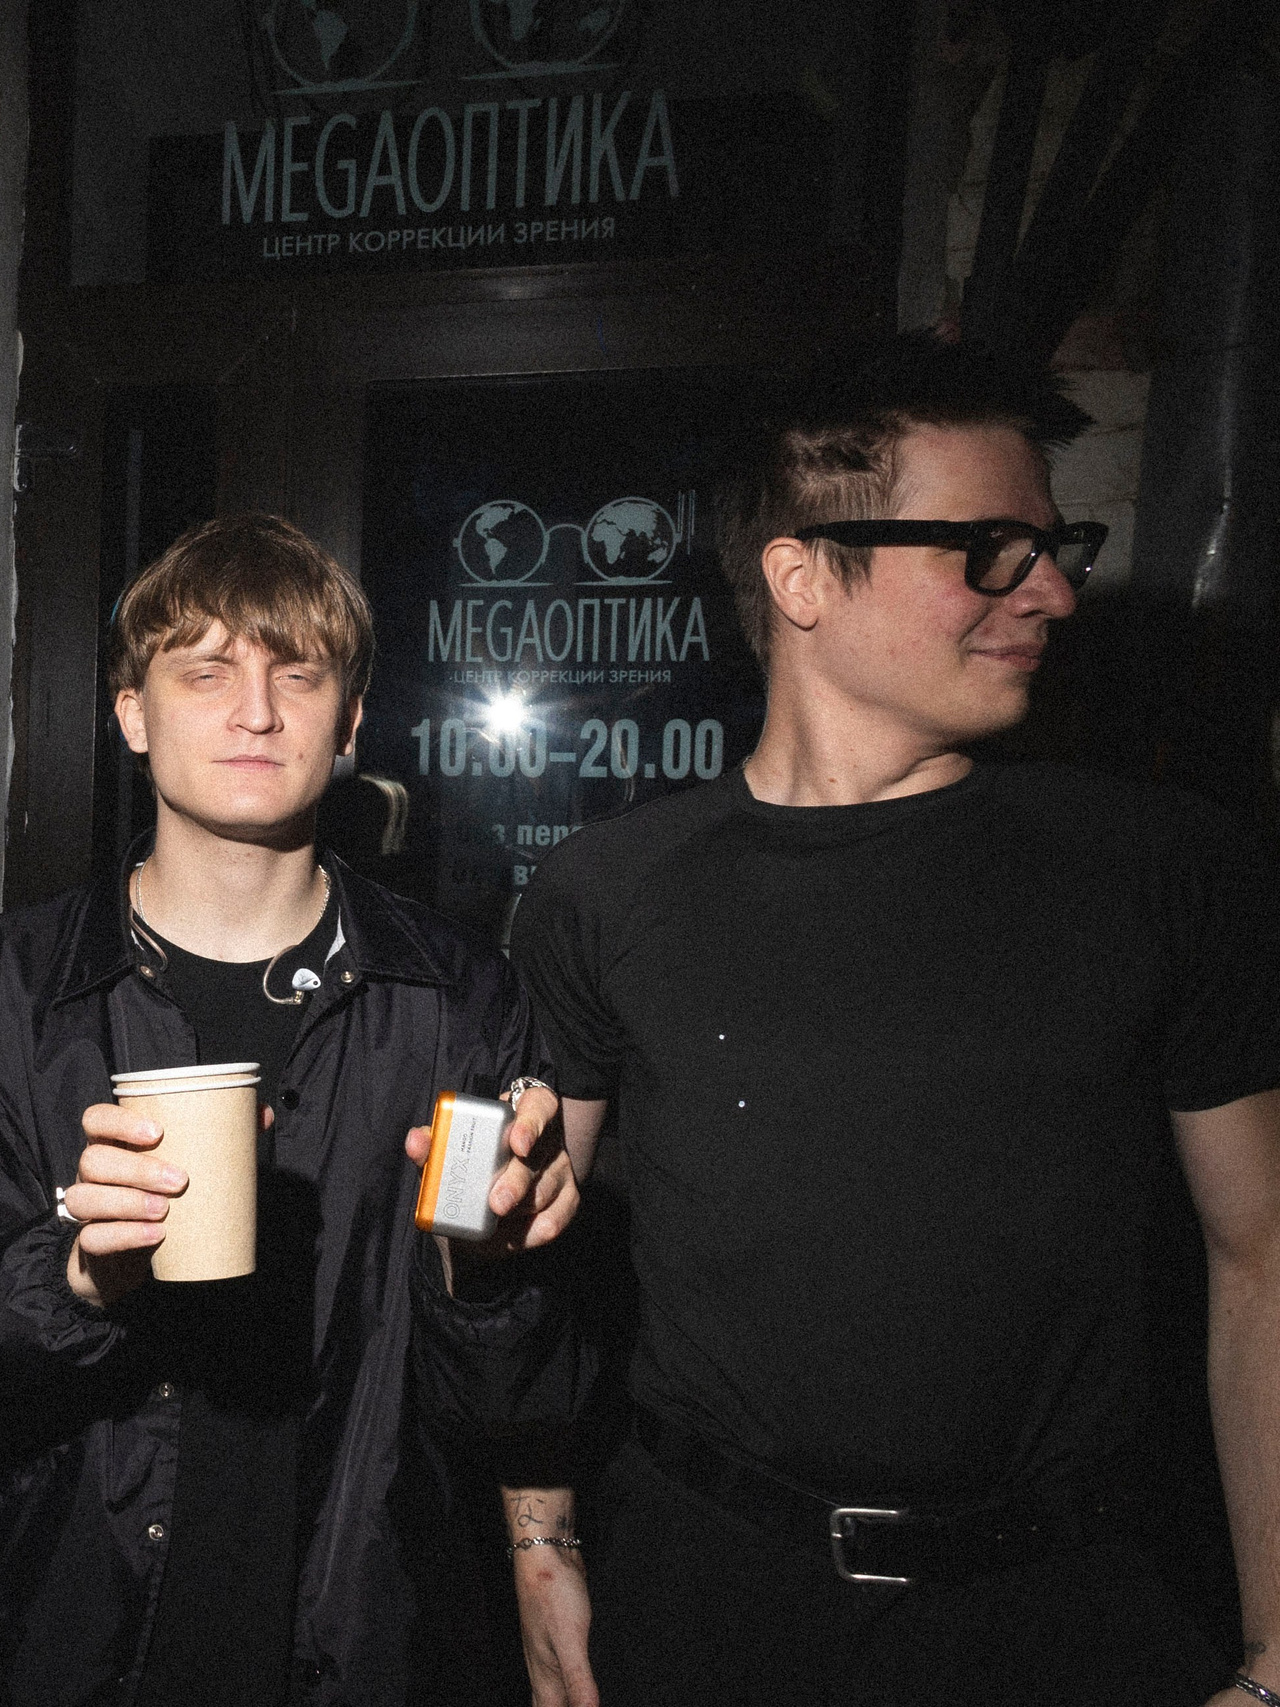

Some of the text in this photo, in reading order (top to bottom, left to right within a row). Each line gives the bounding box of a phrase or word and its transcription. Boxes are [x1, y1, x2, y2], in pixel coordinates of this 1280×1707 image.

[263, 217, 615, 260] ЦЕНТР КОРРЕКЦИИ ЗРЕНИЯ
[453, 669, 672, 686] ЦЕНТР КОРРЕКЦИИ ЗРЕНИЯ
[443, 1156, 469, 1219] ONYX
